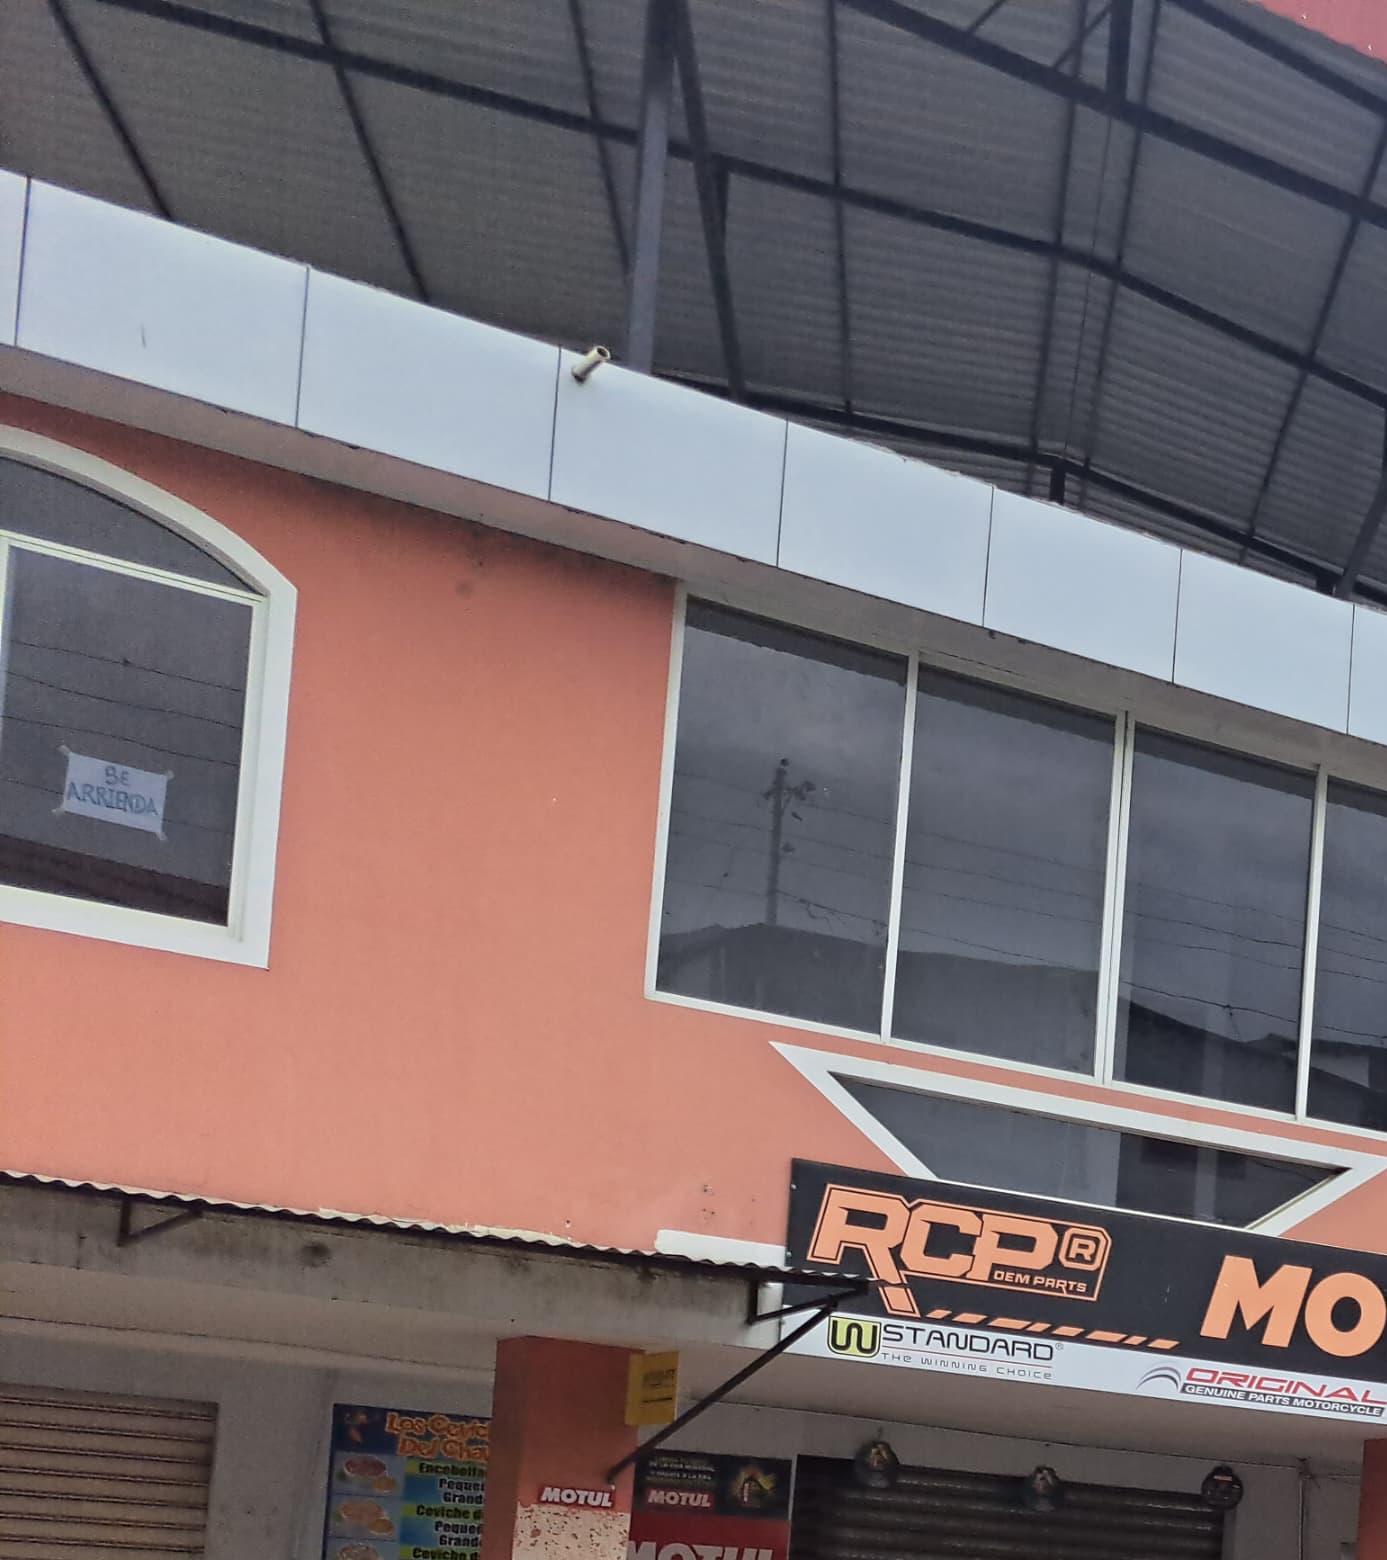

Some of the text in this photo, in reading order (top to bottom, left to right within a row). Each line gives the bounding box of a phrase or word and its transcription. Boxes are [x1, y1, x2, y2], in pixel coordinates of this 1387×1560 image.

[105, 766, 130, 787] SE
[67, 782, 159, 816] ARRIENDA
[993, 1270, 1087, 1295] OEM PARTS
[1186, 1367, 1387, 1405] ORIGINAL
[1185, 1385, 1382, 1416] GENUINE PARTS MOTORCYCLE
[541, 1486, 613, 1508] MOTUL
[648, 1489, 711, 1508] MOTUL
